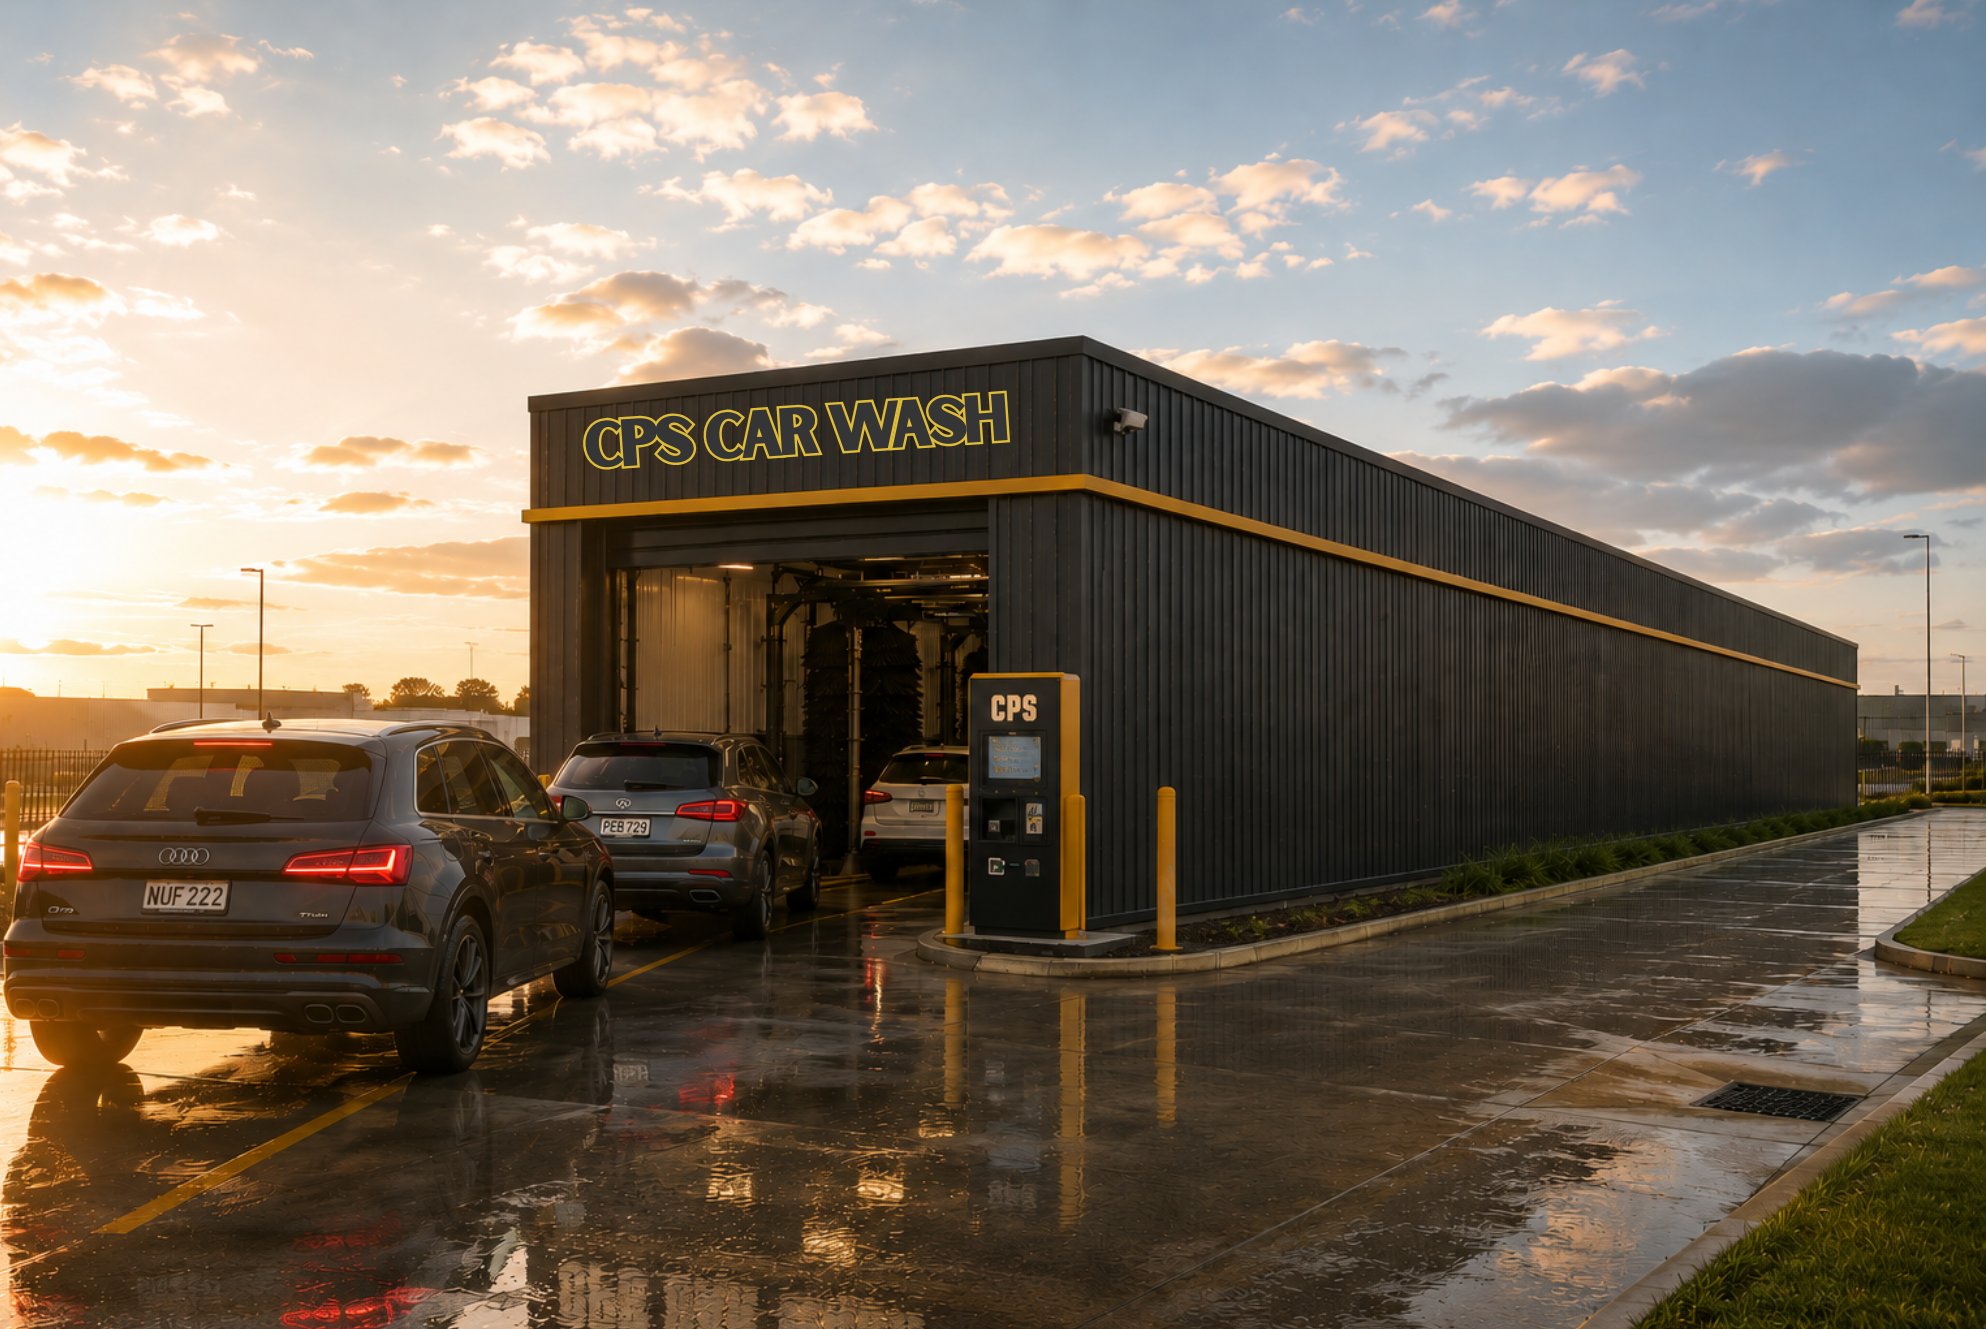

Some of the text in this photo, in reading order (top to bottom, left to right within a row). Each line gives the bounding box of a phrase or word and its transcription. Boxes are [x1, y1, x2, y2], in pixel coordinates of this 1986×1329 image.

[583, 390, 1011, 470] CPS CAR WASH
[991, 694, 1037, 722] CPS
[603, 820, 648, 834] PEB 729
[147, 885, 224, 906] NUF 222
